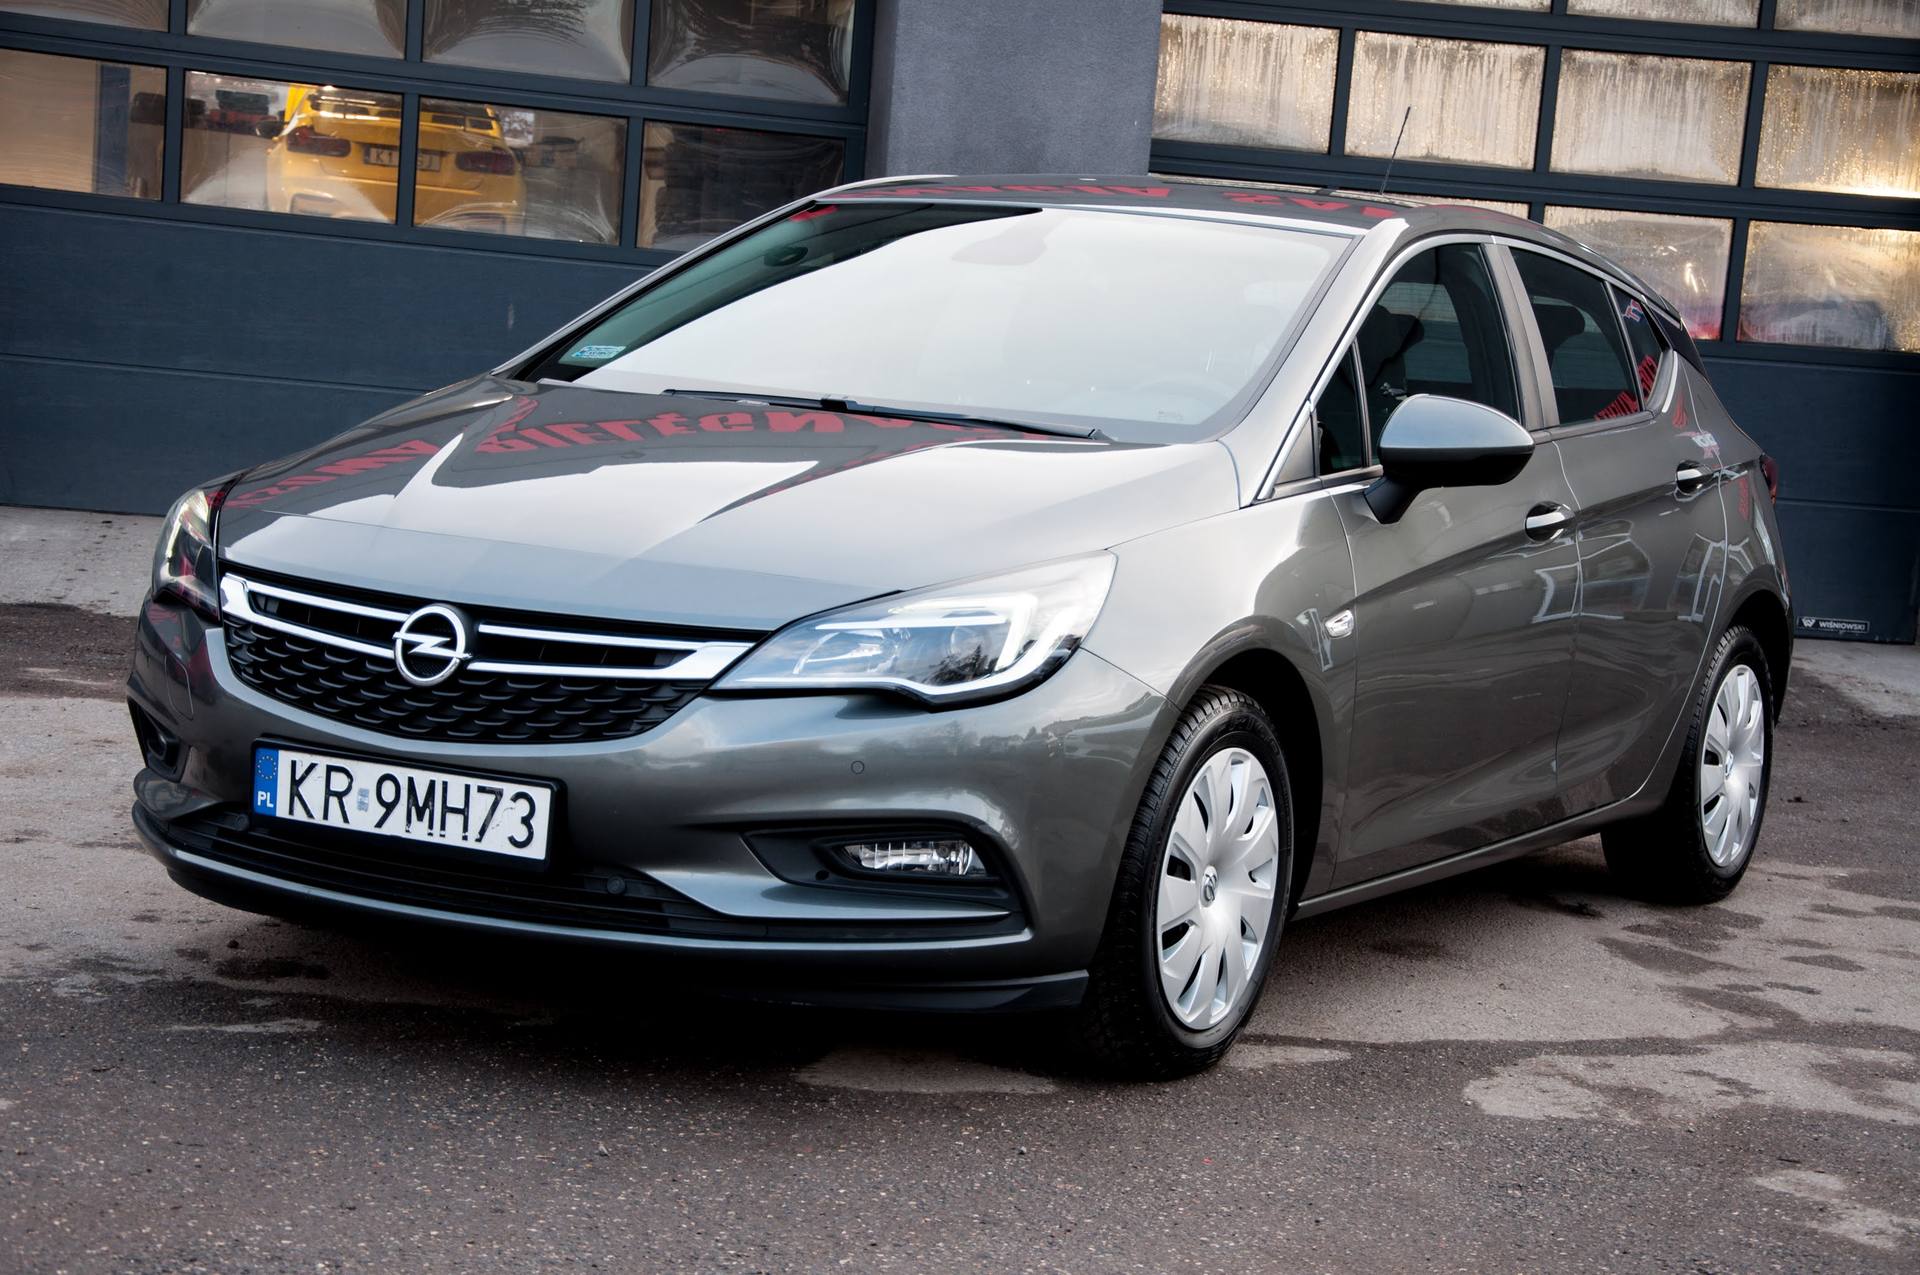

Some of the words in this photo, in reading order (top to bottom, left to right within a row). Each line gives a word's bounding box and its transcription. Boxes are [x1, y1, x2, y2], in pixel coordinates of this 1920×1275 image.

[257, 790, 274, 808] PL
[288, 759, 354, 824] KR
[374, 773, 536, 849] 9MH73
